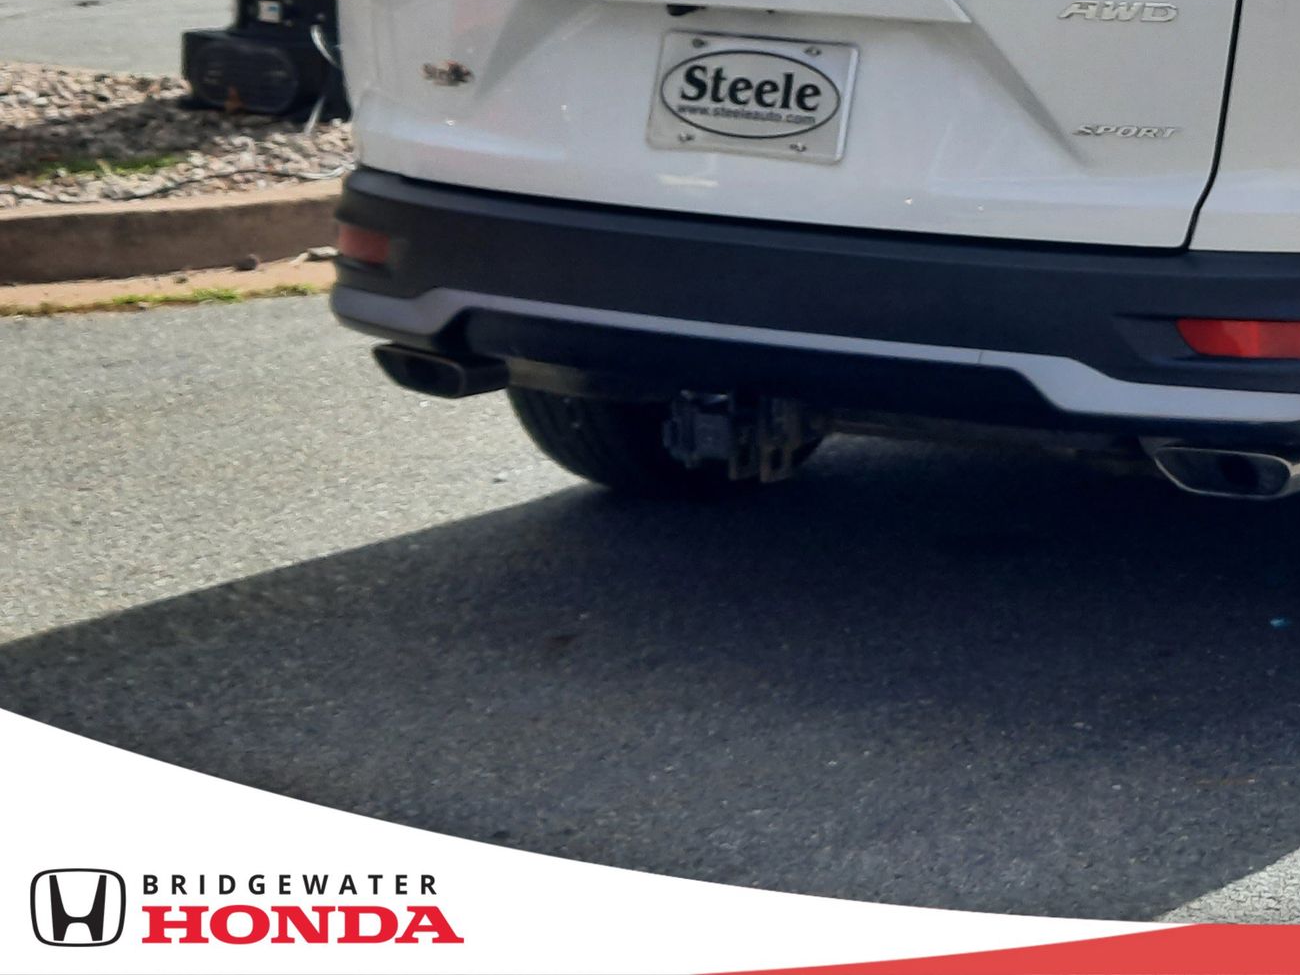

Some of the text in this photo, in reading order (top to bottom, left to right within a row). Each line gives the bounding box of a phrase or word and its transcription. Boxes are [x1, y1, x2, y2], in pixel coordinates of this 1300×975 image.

[1057, 0, 1179, 23] AWD
[680, 64, 821, 113] Steele
[1072, 124, 1180, 139] SPORT
